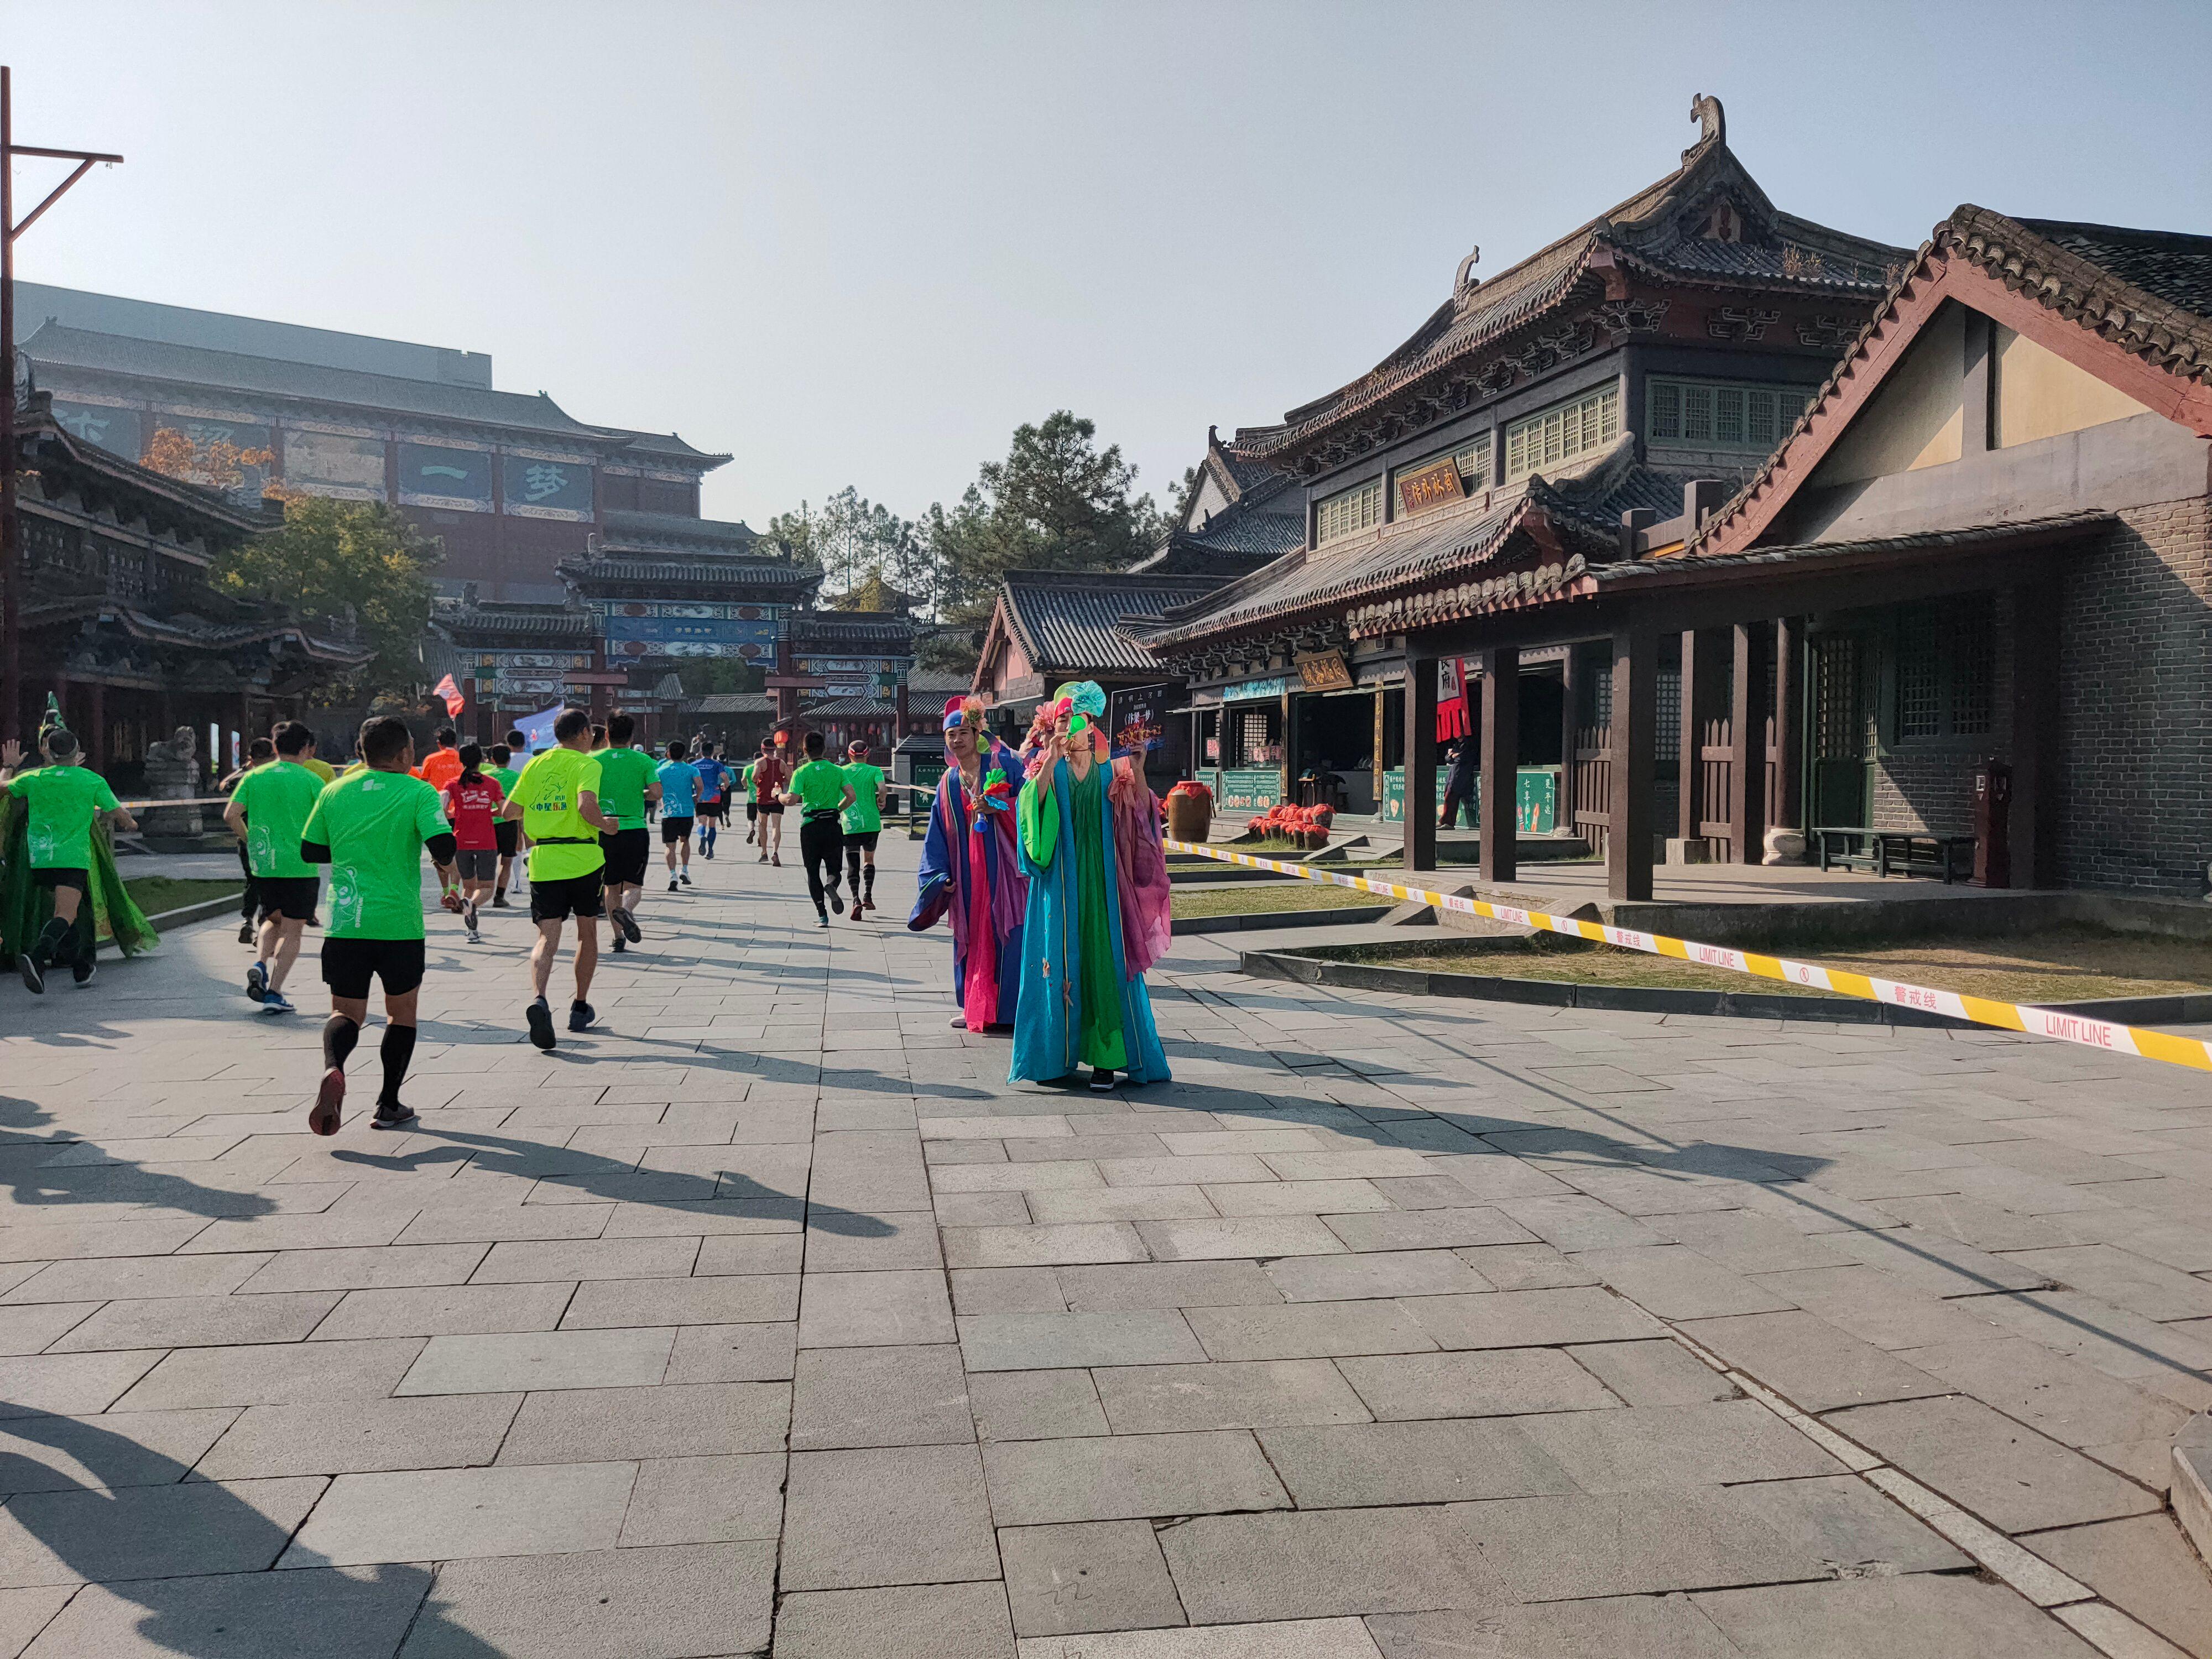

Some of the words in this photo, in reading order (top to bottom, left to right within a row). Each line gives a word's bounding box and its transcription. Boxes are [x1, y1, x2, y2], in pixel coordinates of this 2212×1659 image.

[1501, 908, 1512, 921] LIMIT
[1512, 910, 1523, 922] LINE
[1616, 931, 1641, 947] 警戒线
[1699, 946, 1717, 964] LIMIT
[1718, 950, 1735, 967] LINE
[1895, 986, 1937, 1009] 警戒线
[2046, 1015, 2078, 1039] LIMIT
[2081, 1022, 2112, 1047] LINE
